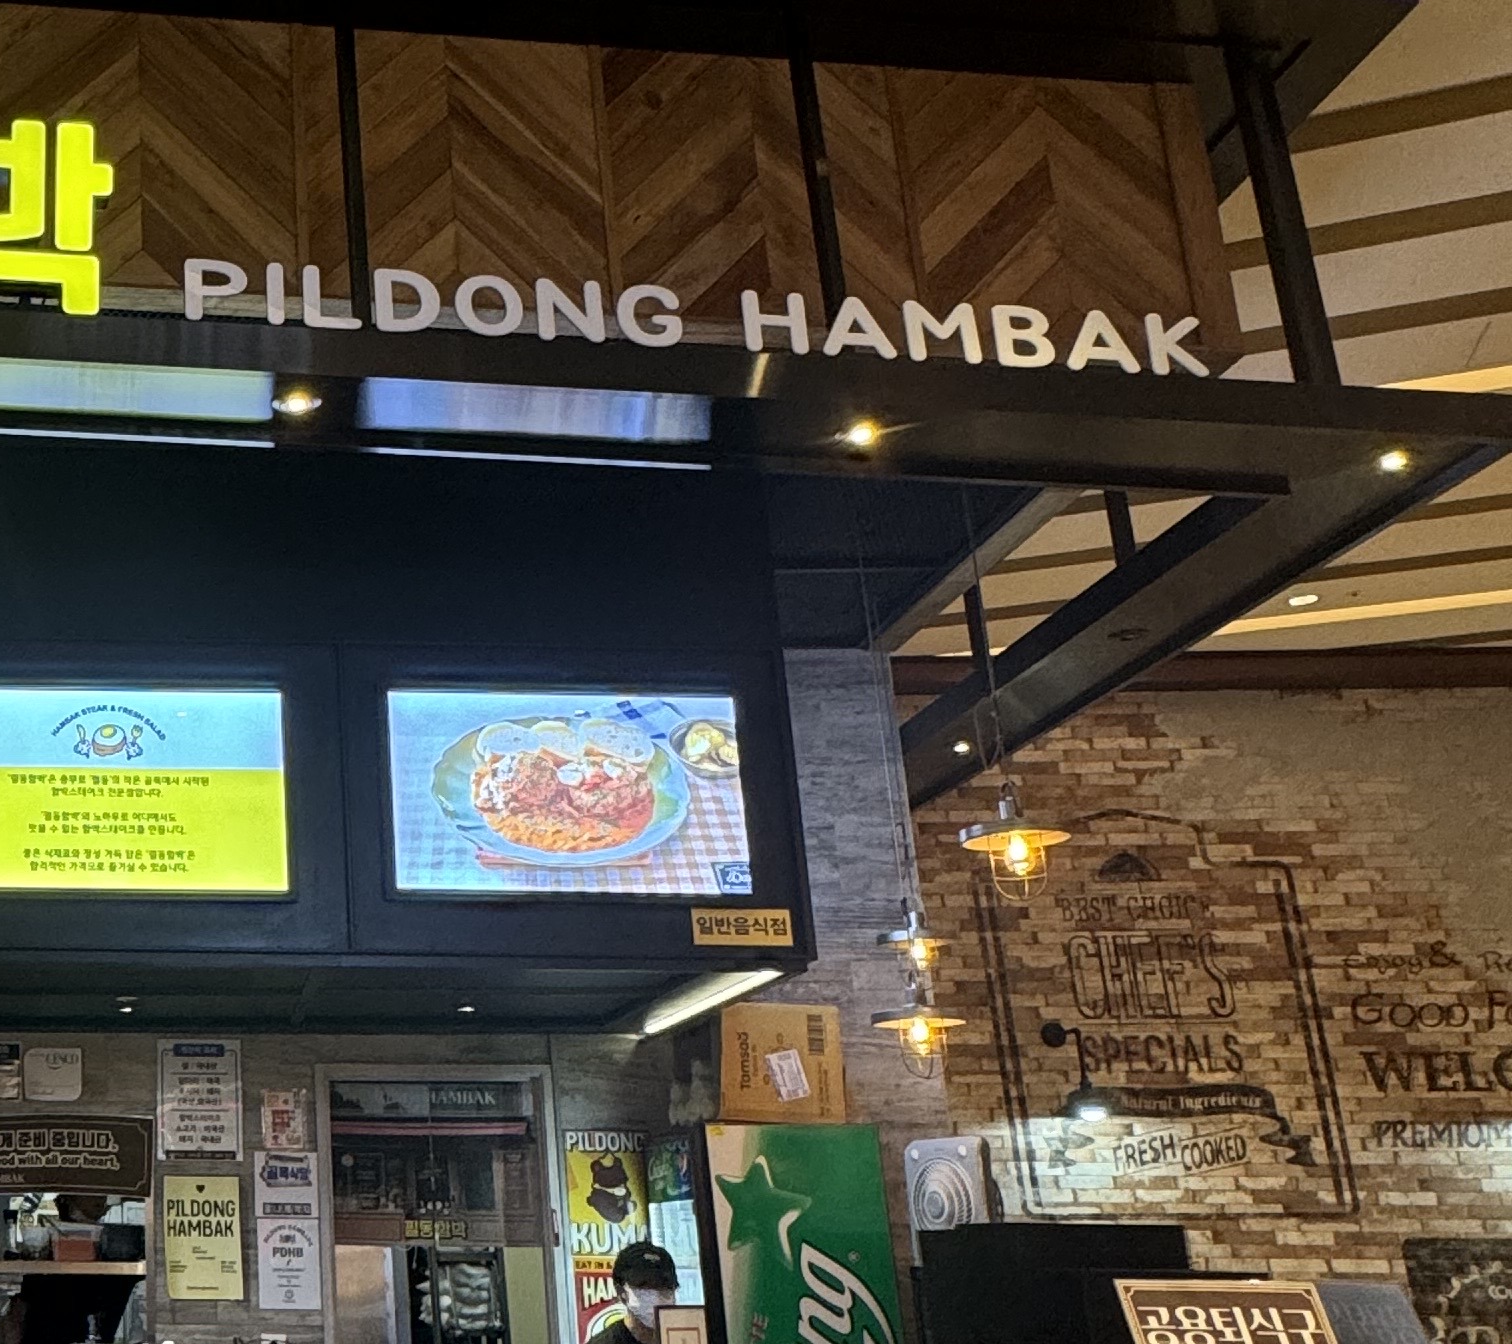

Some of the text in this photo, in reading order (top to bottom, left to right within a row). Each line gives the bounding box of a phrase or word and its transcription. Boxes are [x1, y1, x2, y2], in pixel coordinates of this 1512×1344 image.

[183, 258, 1210, 378] PILDONG HAMBAK
[696, 916, 788, 936] 일반음식점
[1429, 940, 1463, 967] &
[1067, 931, 1236, 1020] CHEF'S
[1082, 1033, 1244, 1074] SPECIALS
[16, 1131, 48, 1150] 준비
[17, 1154, 43, 1167] with
[44, 1154, 59, 1167] all
[60, 1155, 80, 1167] our
[1112, 1132, 1248, 1173] FRESH COOKED
[167, 1199, 236, 1218] PILDONG
[167, 1219, 234, 1237] HAMBAK
[575, 1260, 592, 1270] EAT
